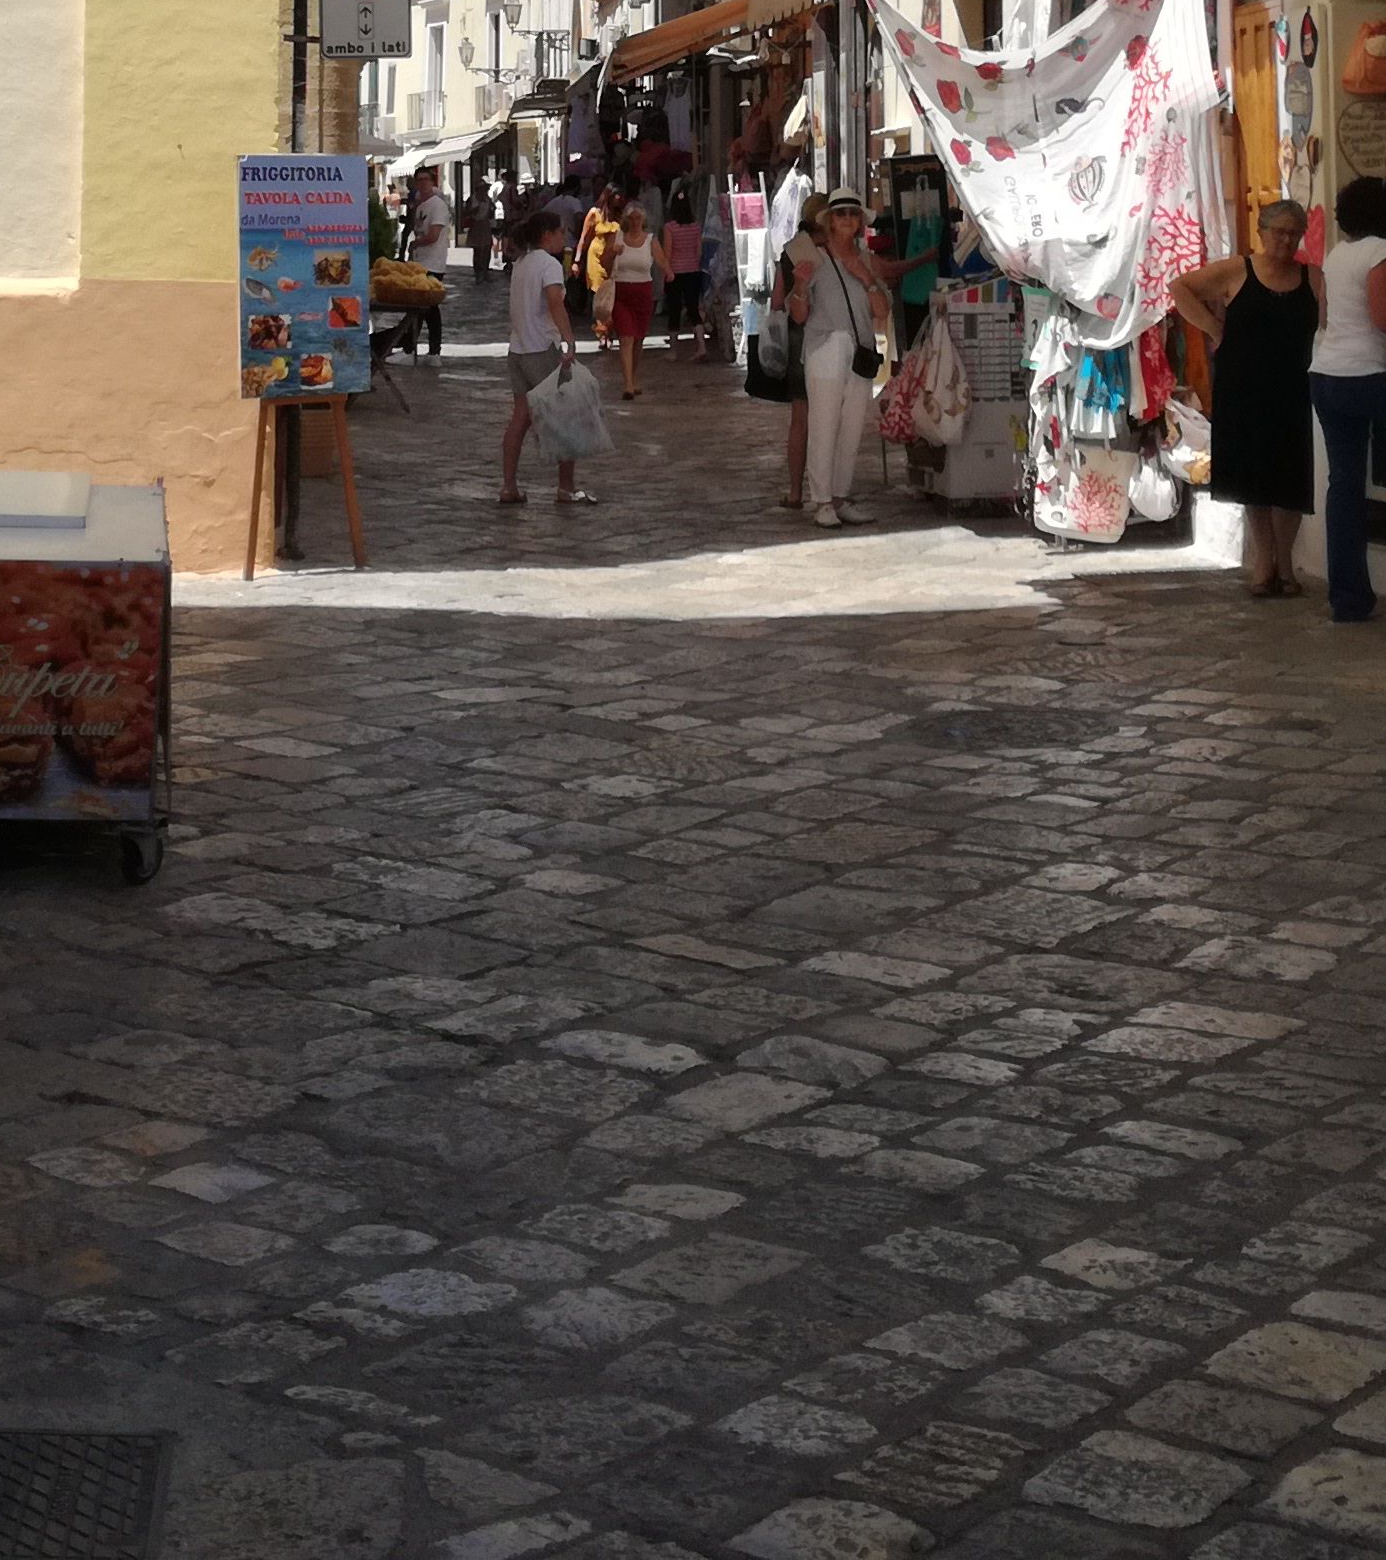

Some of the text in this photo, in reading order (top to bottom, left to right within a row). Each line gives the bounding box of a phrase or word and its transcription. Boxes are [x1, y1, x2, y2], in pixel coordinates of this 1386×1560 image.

[326, 41, 364, 54] ambo
[382, 41, 406, 53] lati
[241, 166, 343, 182] FRIGGITORIA
[245, 192, 354, 205] TAVOLA CALDA
[241, 214, 301, 226] da Morena
[61, 724, 75, 736] a
